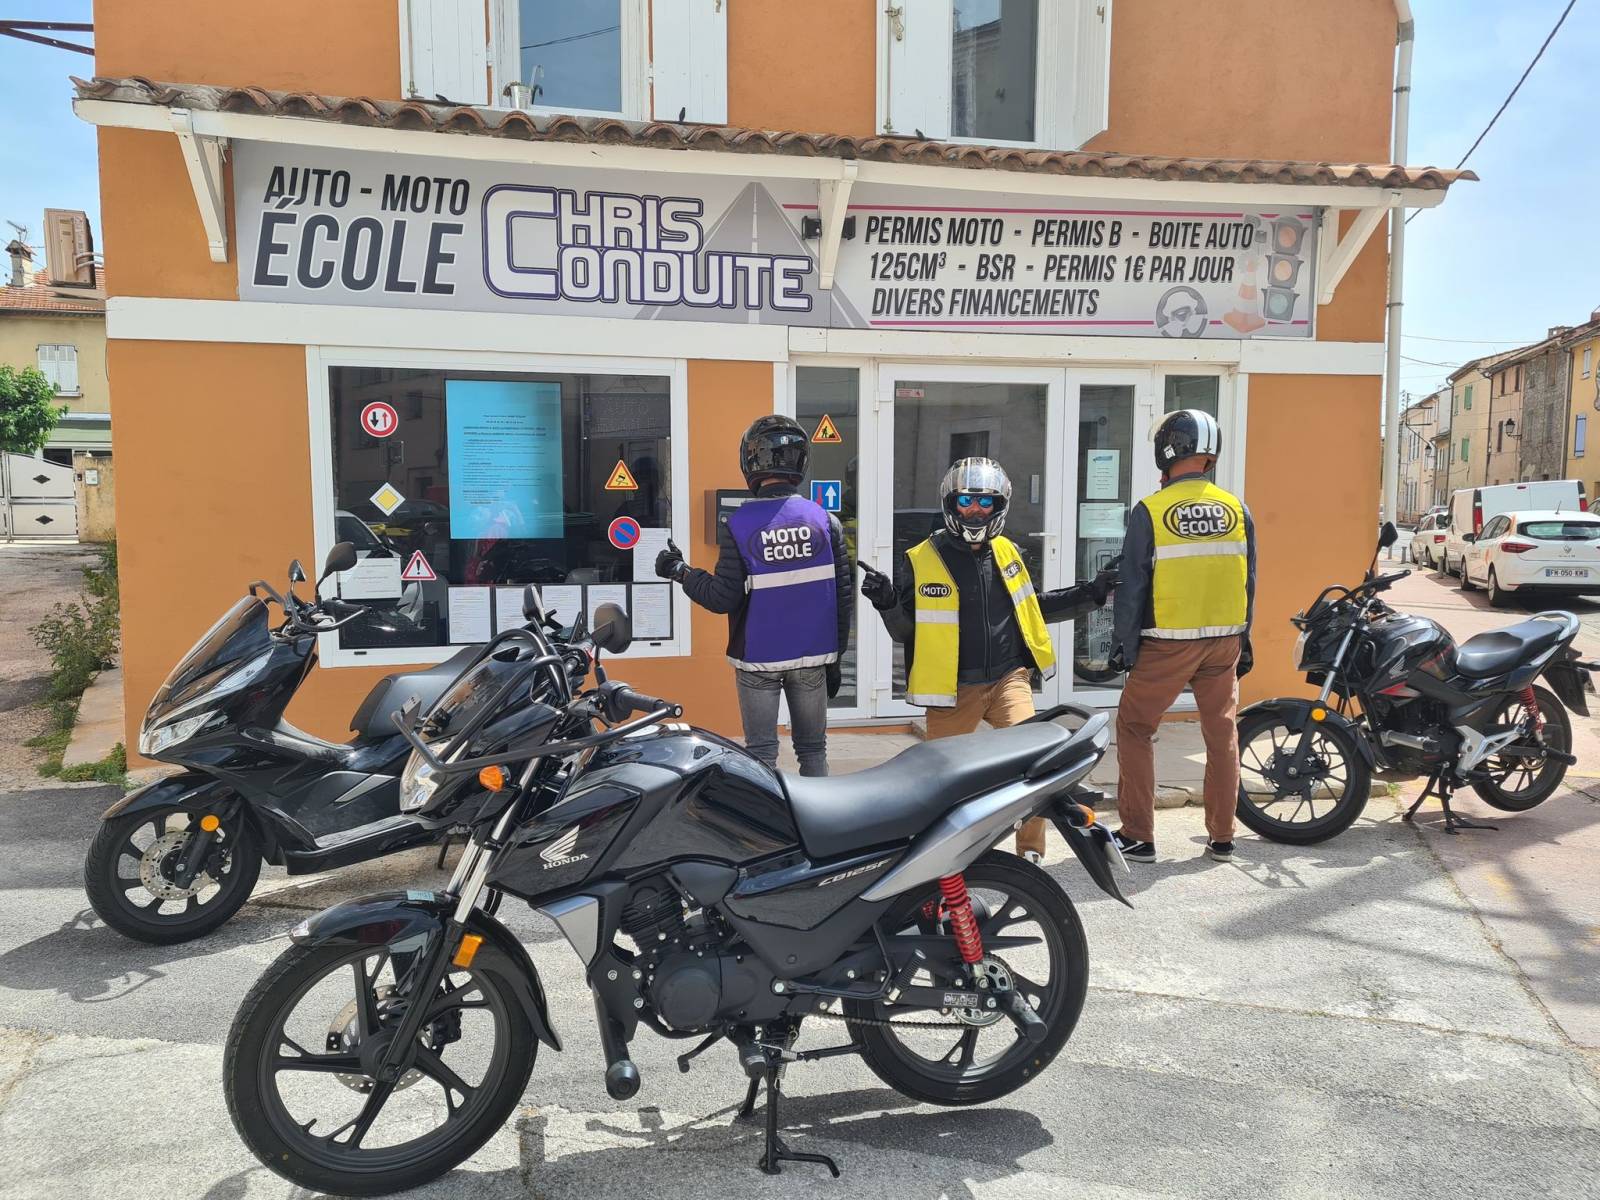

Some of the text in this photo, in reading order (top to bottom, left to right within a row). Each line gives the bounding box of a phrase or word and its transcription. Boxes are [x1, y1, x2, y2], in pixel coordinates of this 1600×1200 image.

[264, 165, 351, 207] AUTO
[381, 173, 470, 216] MOTO
[865, 215, 943, 245] PERMIS
[947, 217, 1004, 246] MOTO
[1032, 219, 1105, 247] PERMIS
[1109, 220, 1122, 247] B
[1149, 221, 1203, 248] BOITE
[1205, 222, 1255, 249] AUTO
[253, 197, 464, 295] ÉCOLE
[870, 251, 947, 280] 125CM³
[976, 253, 1016, 281] BSR
[1043, 254, 1117, 281] PERMIS
[1124, 255, 1146, 281] 1€
[1149, 255, 1189, 282] PAR
[1188, 256, 1234, 283] JOUR
[872, 287, 1100, 317] DIVERS FINANCEMENTS
[1176, 505, 1225, 520] MOTO
[760, 526, 811, 545] MOTO
[1178, 520, 1227, 535] ECOLE
[763, 542, 813, 562] ECOLE
[922, 586, 949, 596] MOTO
[543, 853, 589, 870] HONDA
